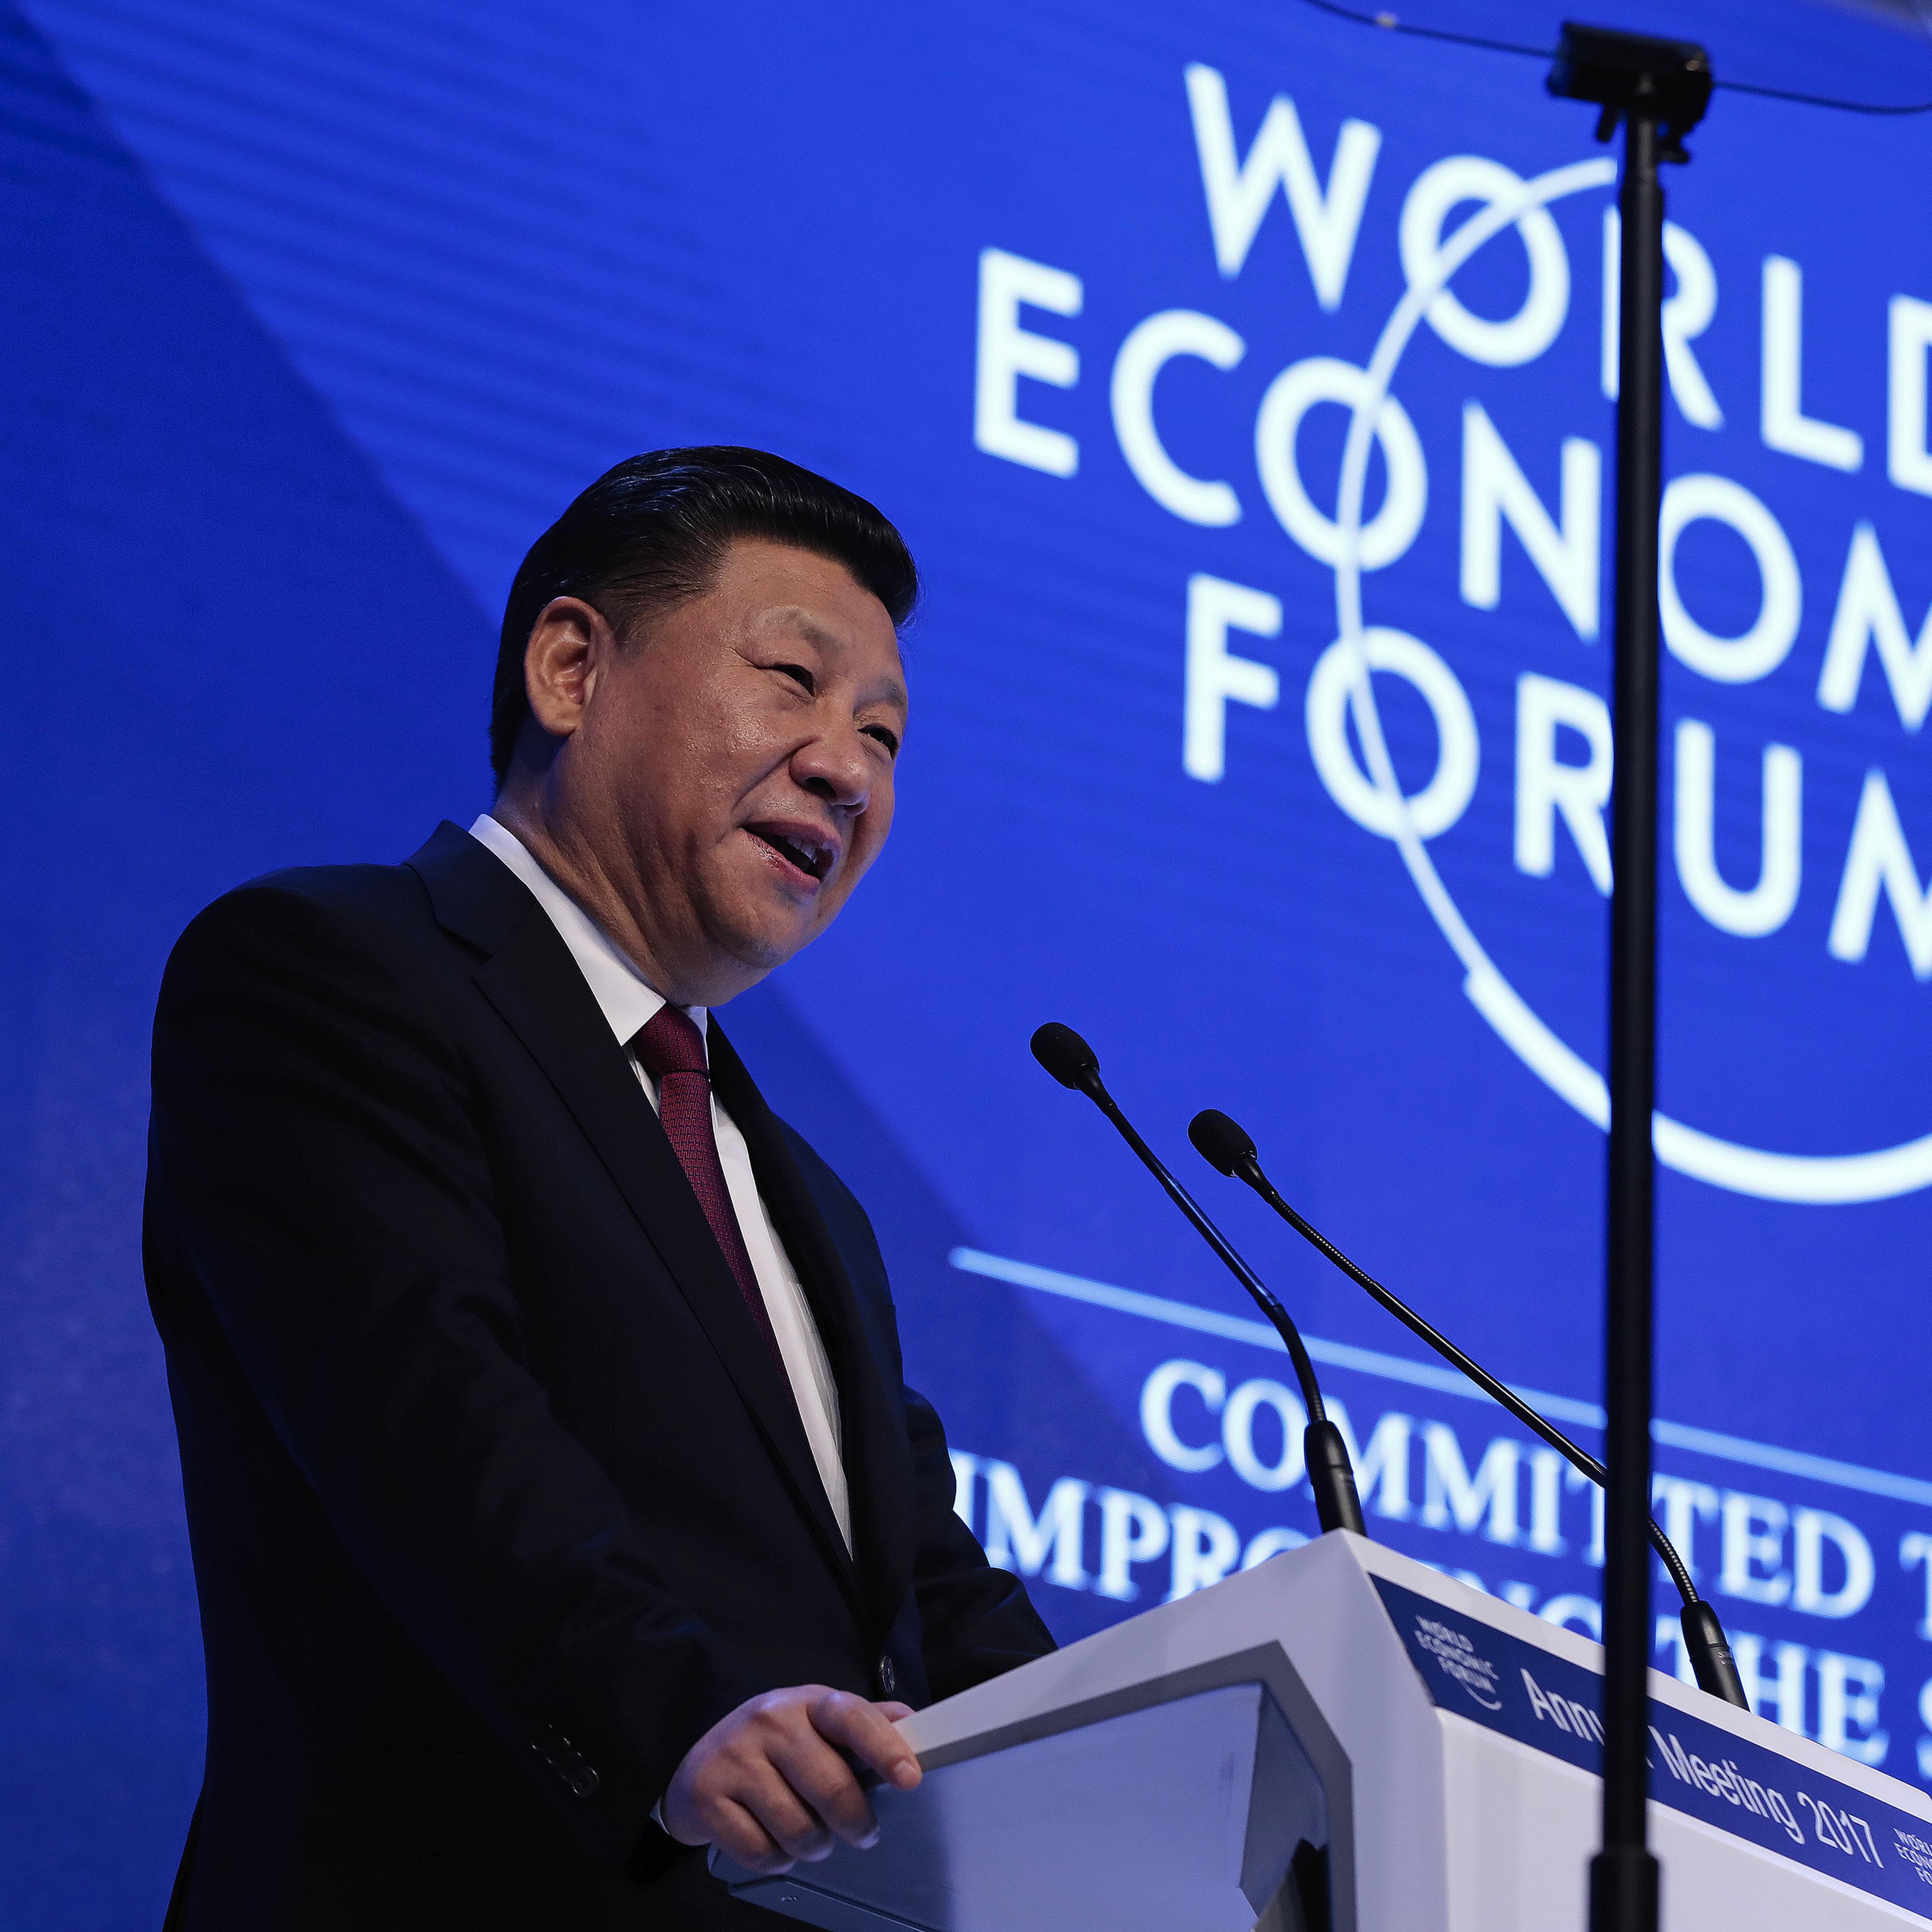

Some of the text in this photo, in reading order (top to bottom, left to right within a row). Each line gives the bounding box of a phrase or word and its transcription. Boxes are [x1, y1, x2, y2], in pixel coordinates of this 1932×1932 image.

[973, 244, 1932, 736] ECONOM
[1647, 1724, 1806, 1845] Meeting
[1797, 1791, 1885, 1869] 2017
[1893, 1827, 1932, 1857] WORL
